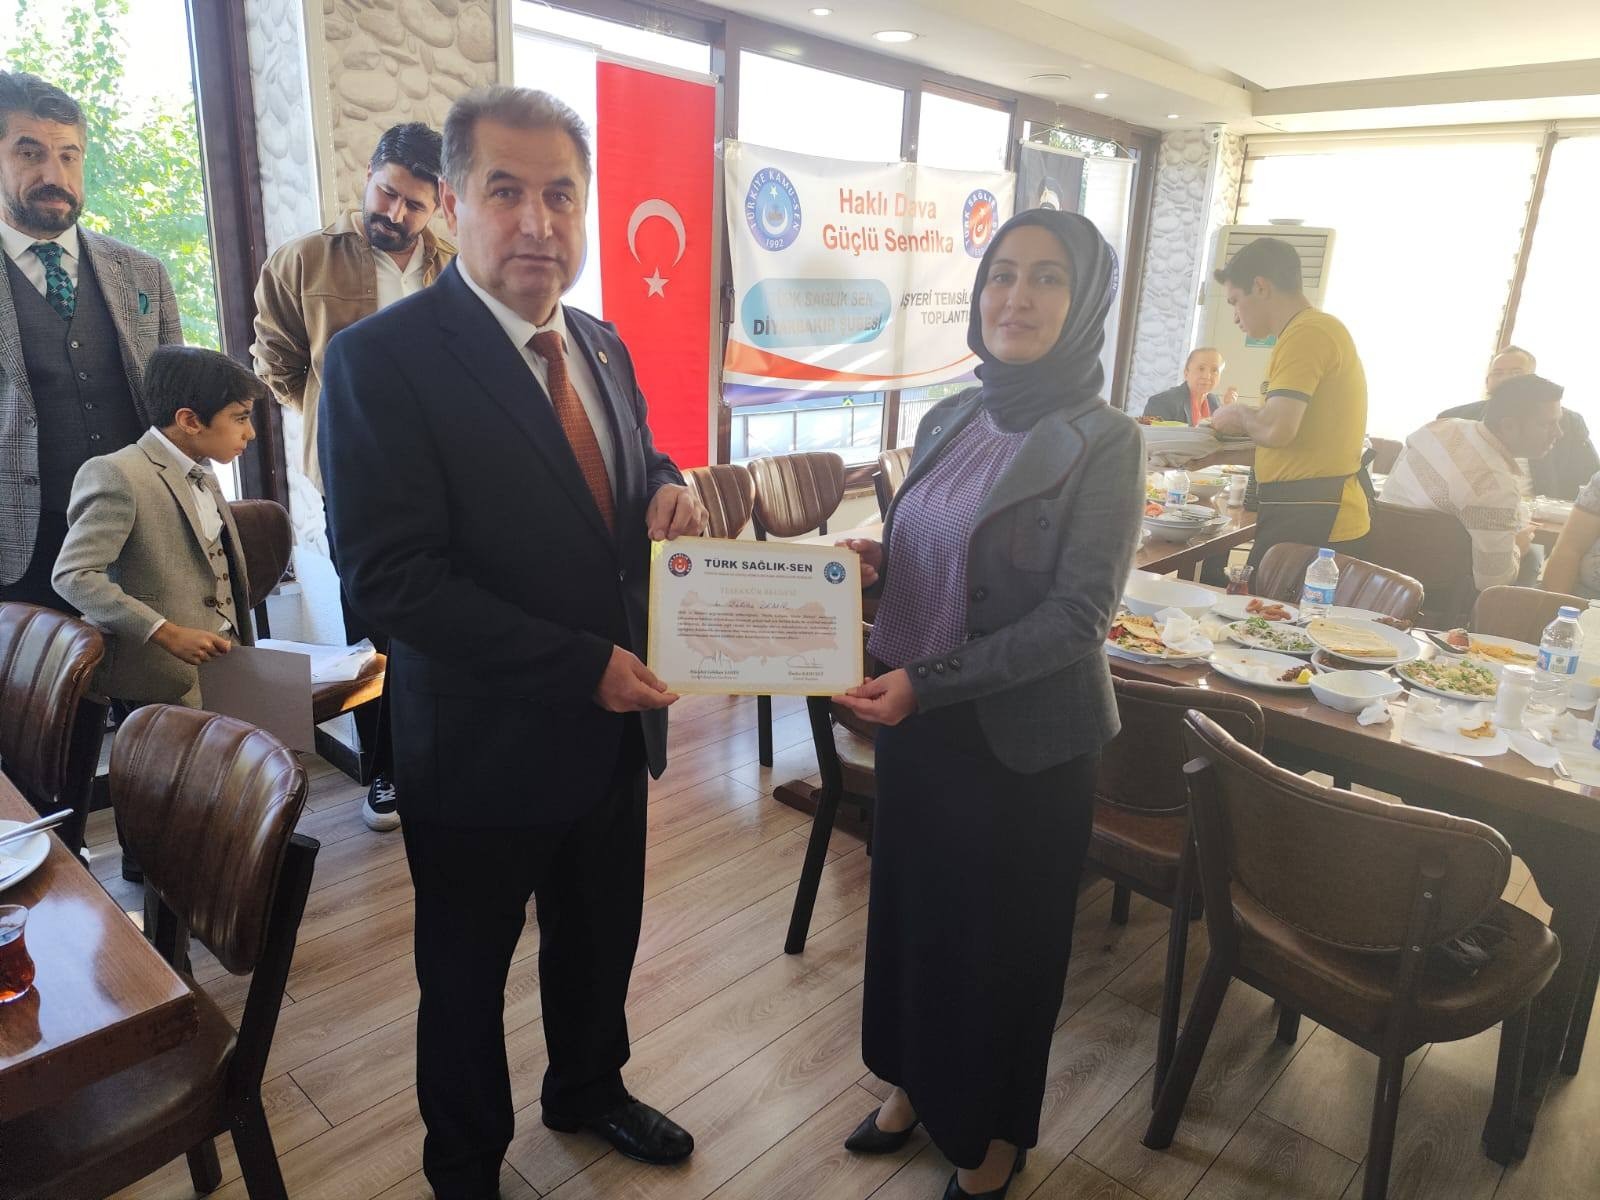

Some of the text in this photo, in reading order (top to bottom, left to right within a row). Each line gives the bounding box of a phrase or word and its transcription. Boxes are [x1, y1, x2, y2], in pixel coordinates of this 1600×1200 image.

[839, 187, 938, 220] Haklı Dava
[766, 239, 785, 248] 1992
[822, 223, 879, 257] Güçlü
[883, 227, 955, 254] Sendika
[900, 287, 934, 310] İŞYERİ
[703, 557, 738, 569] TÜRK
[741, 559, 813, 573] SAĞLIK-SEN
